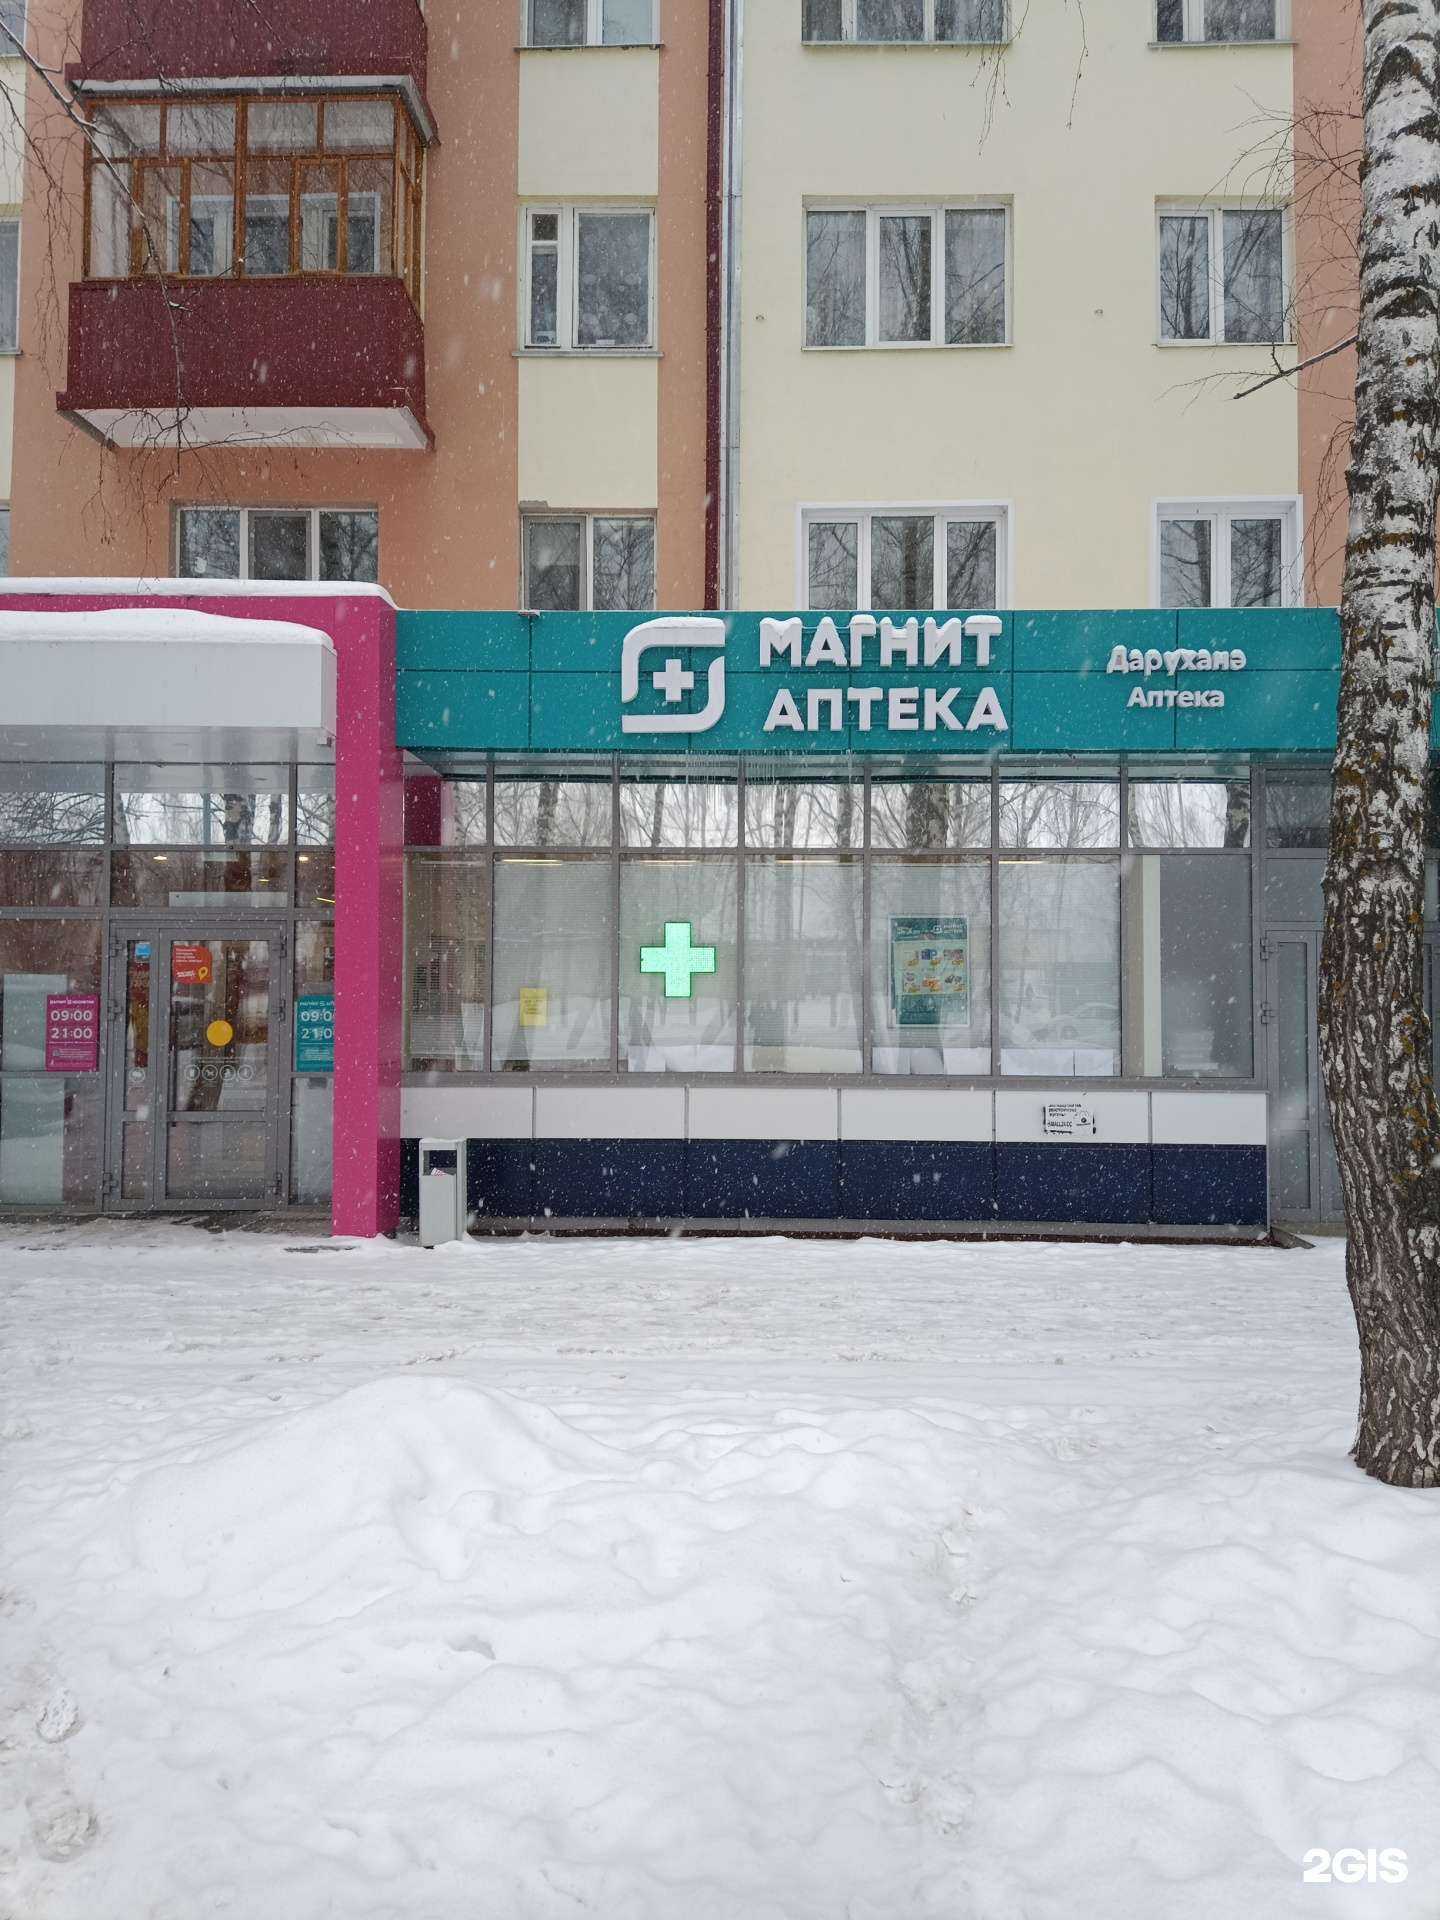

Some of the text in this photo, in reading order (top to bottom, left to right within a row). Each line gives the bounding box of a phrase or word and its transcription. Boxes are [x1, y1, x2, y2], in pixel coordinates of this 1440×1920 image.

[759, 615, 1003, 667] МАГНИТ
[1126, 687, 1225, 707] Аптека
[763, 686, 1008, 732] АПТЕКА
[51, 1010, 92, 1021] 09:00
[301, 1011, 334, 1022] 09:0
[51, 1028, 92, 1039] 21:00
